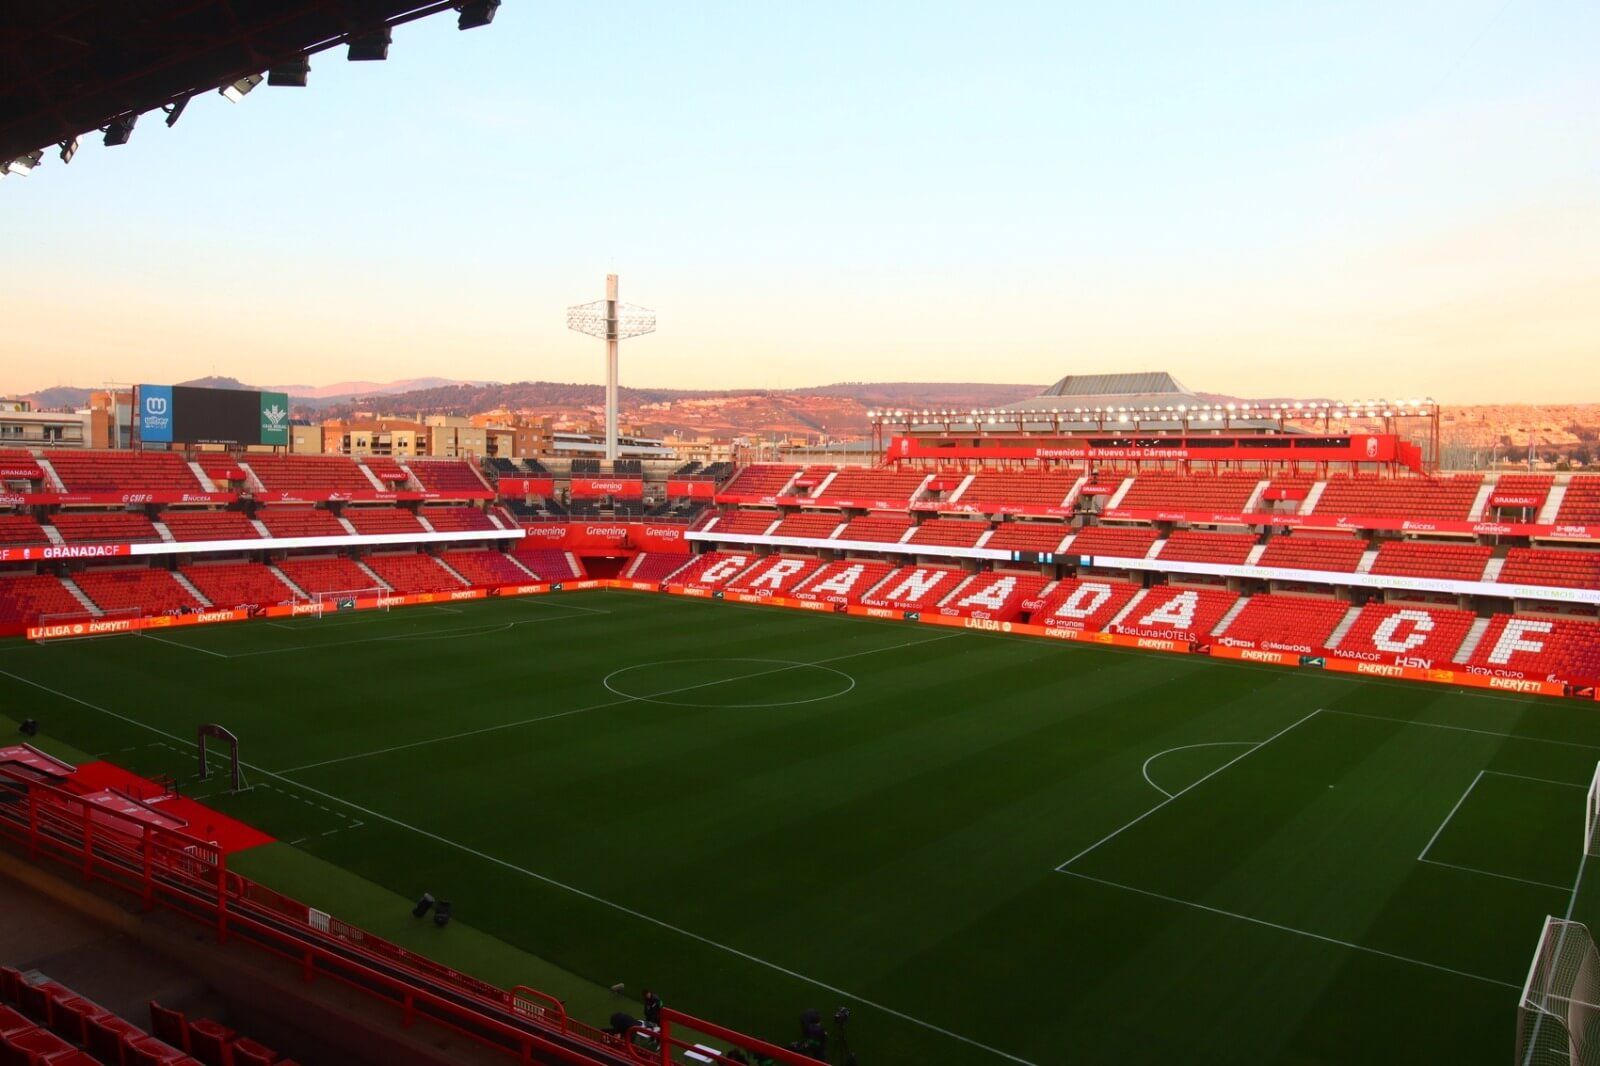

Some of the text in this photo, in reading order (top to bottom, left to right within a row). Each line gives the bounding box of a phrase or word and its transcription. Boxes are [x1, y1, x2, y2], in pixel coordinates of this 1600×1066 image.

[591, 481, 622, 492] Greening
[528, 526, 566, 537] Greening
[586, 526, 626, 537] Greening
[646, 527, 679, 538] Greening
[43, 545, 120, 559] GRANADACF
[90, 621, 130, 632] ENERYETI
[965, 617, 1000, 631] LALIGA
[31, 626, 70, 638] LALIGA
[1241, 650, 1282, 662] ENERYETI
[1334, 650, 1381, 661] MARACOF
[1395, 656, 1432, 669] HSN
[1357, 663, 1403, 676] ENERYETI
[1489, 677, 1541, 692] ENERYETI
